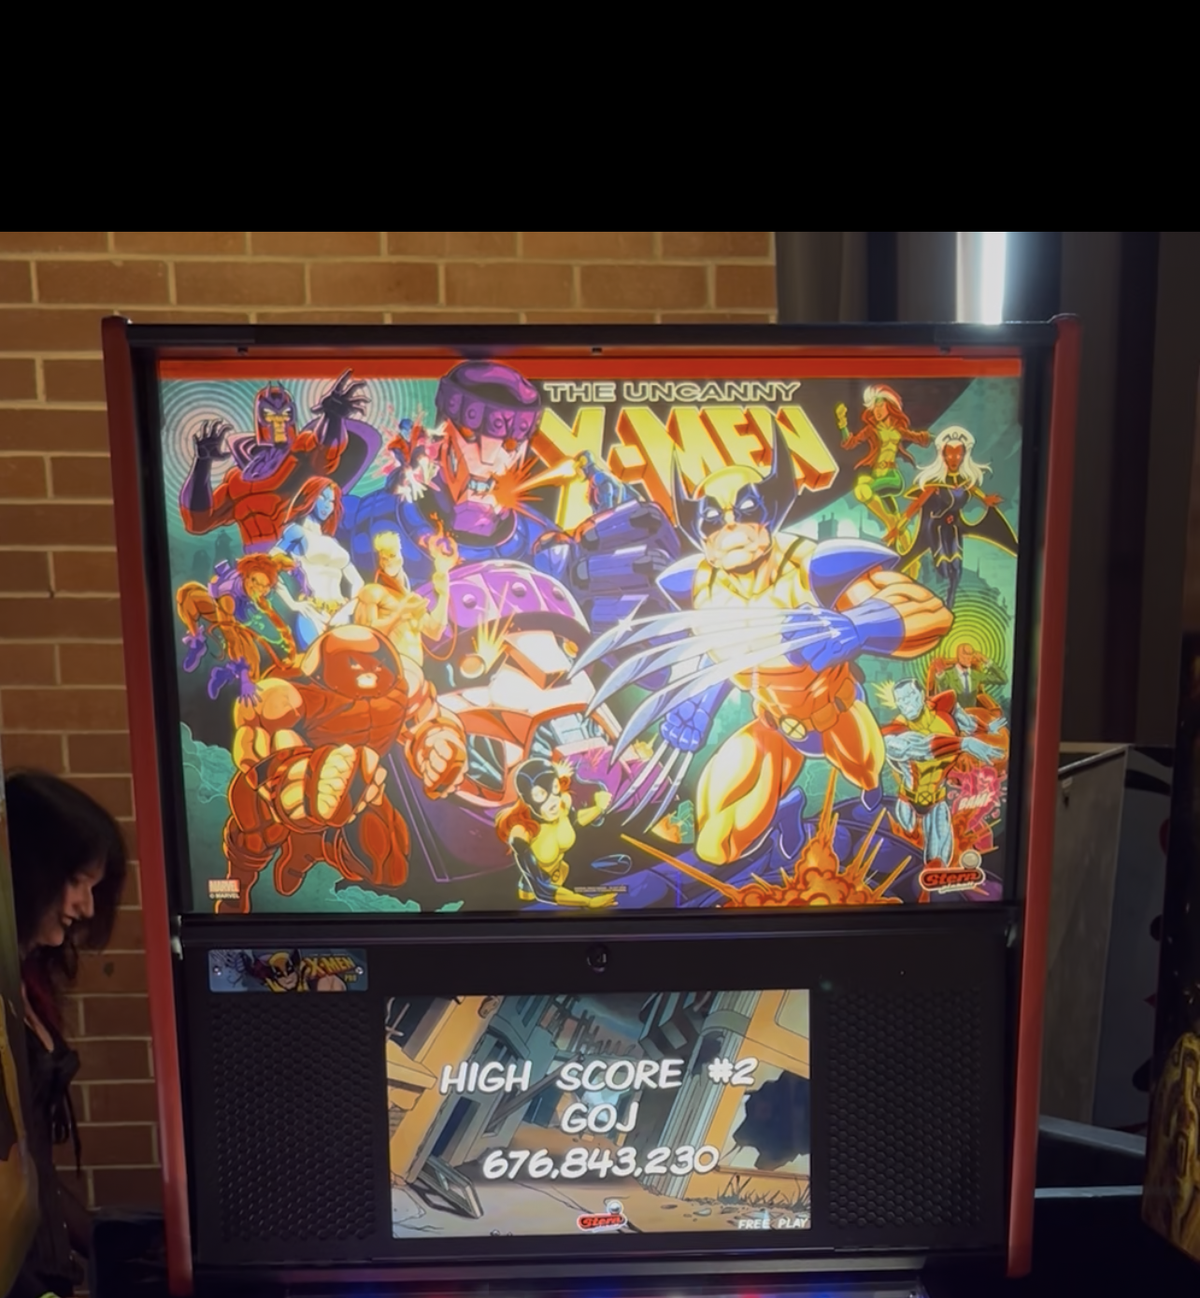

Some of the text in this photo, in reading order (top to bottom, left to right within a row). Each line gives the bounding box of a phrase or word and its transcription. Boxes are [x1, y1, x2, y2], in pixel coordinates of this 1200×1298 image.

[543, 381, 801, 402] THE UNCANNY
[531, 404, 839, 530] X-MEN
[923, 871, 979, 886] Stern
[304, 957, 356, 978] X-MEN
[440, 1057, 758, 1094] HIGH SCORE #2
[561, 1101, 640, 1133] GOJ
[482, 1145, 720, 1179] 676,843,230
[580, 1214, 624, 1228] Stern
[738, 1217, 809, 1230] FREE PLAY
